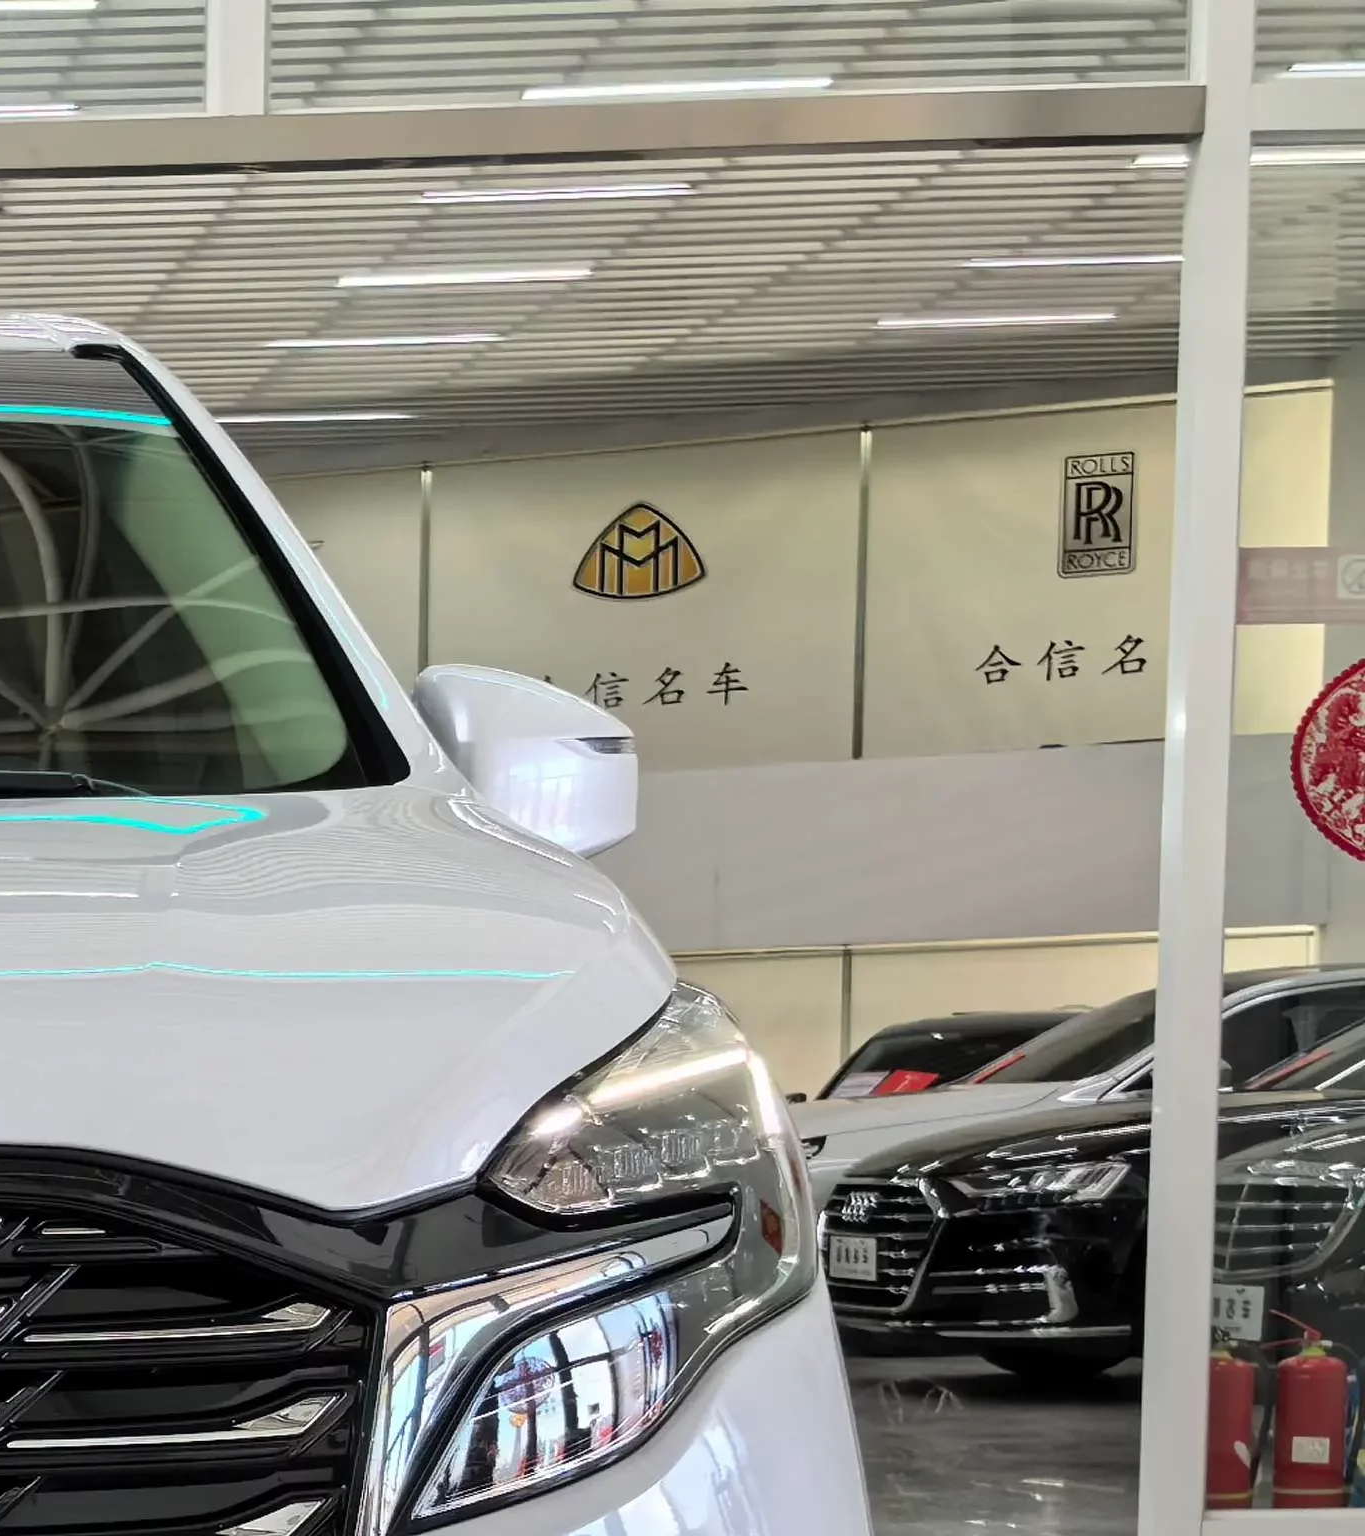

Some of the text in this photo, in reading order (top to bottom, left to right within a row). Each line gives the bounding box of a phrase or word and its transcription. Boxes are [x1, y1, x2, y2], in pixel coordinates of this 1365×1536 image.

[1070, 456, 1130, 476] ROLLS
[1066, 551, 1127, 571] ROYCE
[975, 634, 1147, 685] 合信名
[543, 661, 750, 709] 信名车
